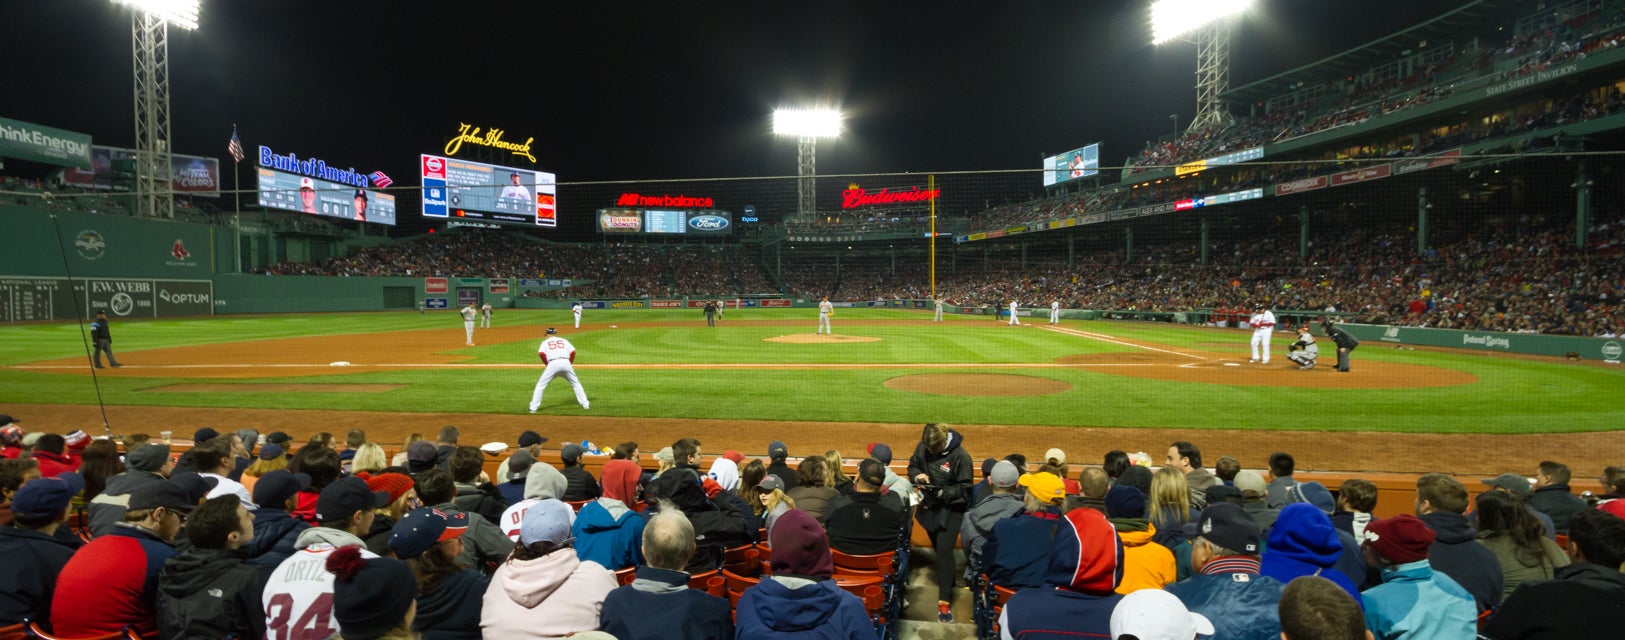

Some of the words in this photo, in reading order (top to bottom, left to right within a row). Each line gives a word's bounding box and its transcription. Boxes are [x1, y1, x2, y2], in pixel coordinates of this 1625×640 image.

[1485, 84, 1506, 97] STATE
[1508, 75, 1535, 90] STREET
[1537, 63, 1577, 81] PAVILION
[445, 122, 483, 156] John
[482, 127, 537, 163] Hancock
[259, 145, 300, 173] Bank
[301, 157, 317, 176] of
[317, 160, 369, 188] America
[639, 196, 662, 207] new
[664, 194, 713, 207] balance
[841, 185, 941, 209] Budweiser
[696, 217, 720, 228] Ford
[741, 216, 758, 224] tyco
[116, 282, 150, 293] WEBB
[172, 294, 209, 304] OPTUM
[1486, 335, 1510, 349] Spring
[262, 592, 337, 640] 34
